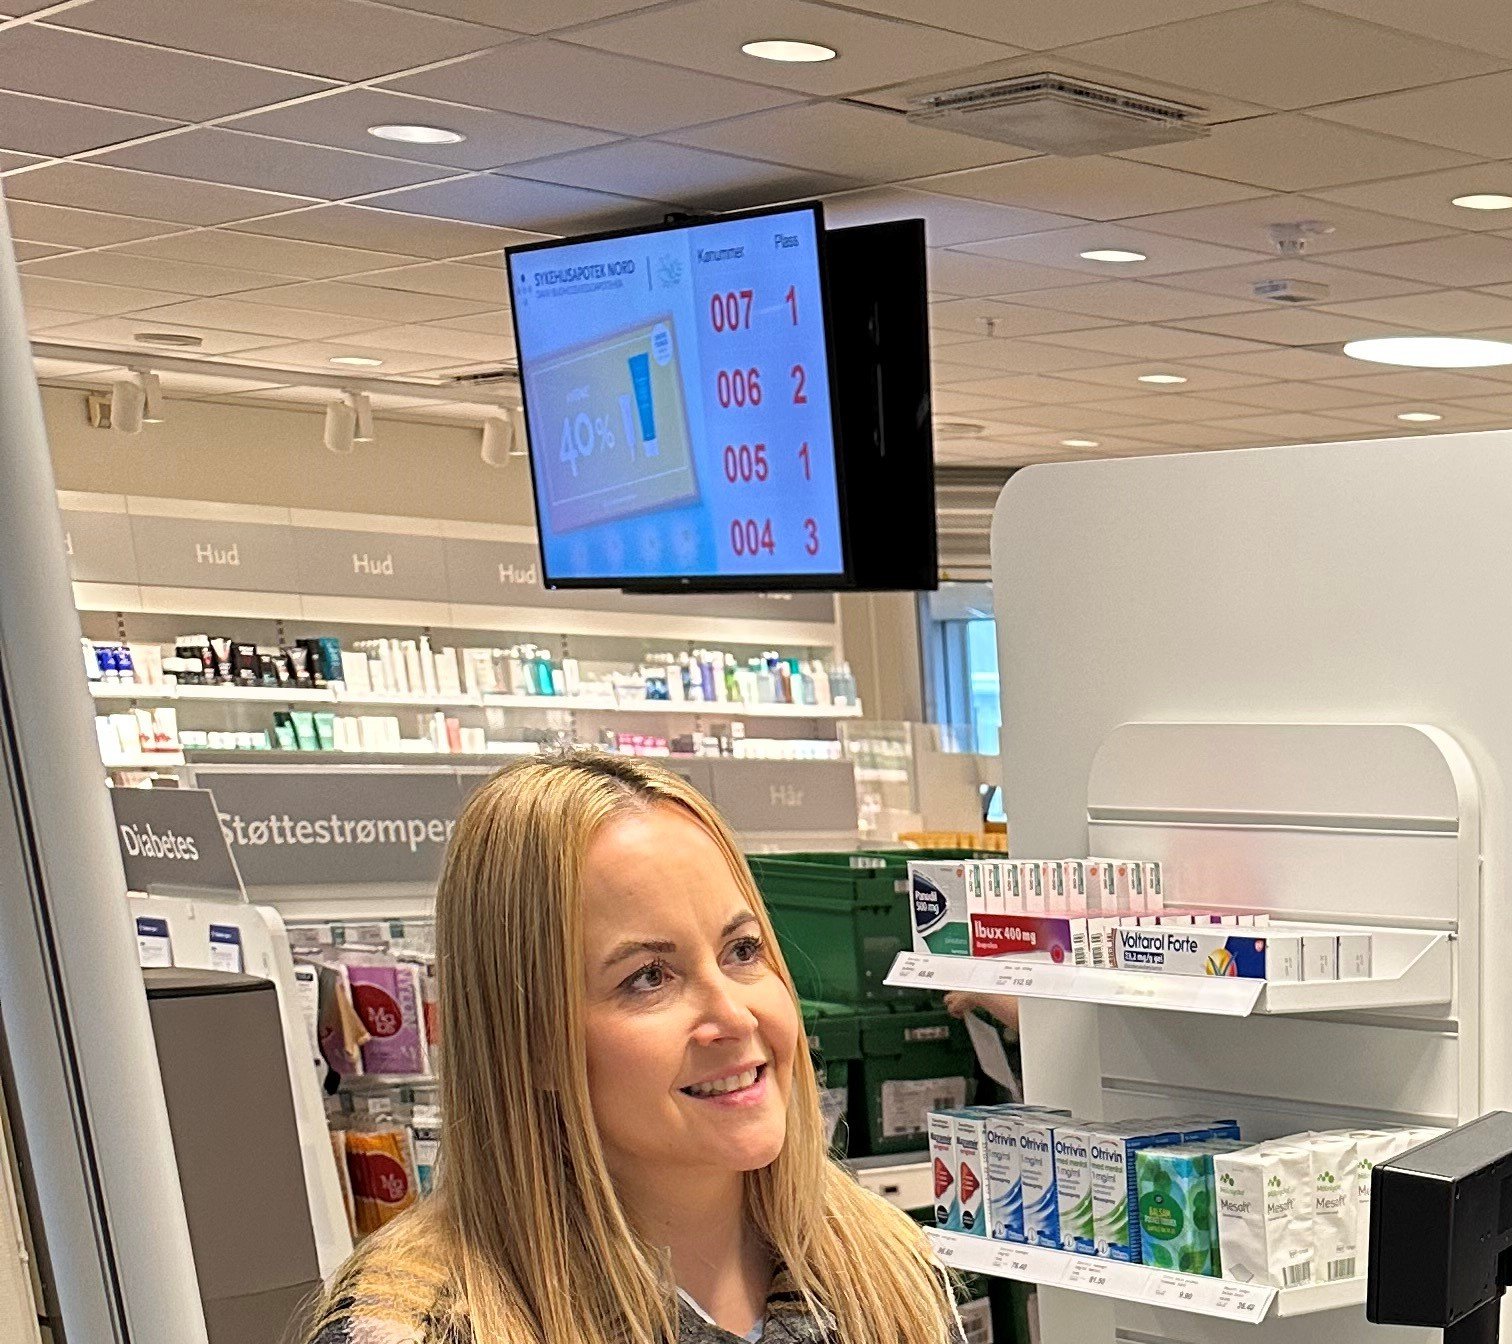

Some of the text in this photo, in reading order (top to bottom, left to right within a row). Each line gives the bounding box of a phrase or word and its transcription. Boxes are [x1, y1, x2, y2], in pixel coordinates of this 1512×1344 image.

[608, 259, 635, 275] NORD
[710, 285, 798, 332] 007 1
[716, 364, 807, 408] 006 2
[559, 412, 616, 477] 40%
[723, 442, 812, 483] 005 1
[730, 517, 819, 557] 004 3
[195, 543, 241, 567] Hud
[353, 552, 395, 575] Hud
[498, 563, 537, 584] Hud
[119, 822, 199, 862] Diabetes
[218, 812, 457, 852] Støttestrømper
[928, 904, 939, 915] mg
[974, 920, 1037, 945] Ibux 400 mg
[1120, 930, 1198, 953] Voltarol Forte
[988, 1130, 1017, 1147] Otrivin
[1020, 1136, 1049, 1153] Otrivin
[1056, 1141, 1087, 1158] Otrivin
[1091, 1146, 1123, 1163] Otrivin
[1220, 1199, 1251, 1213] Mesoft
[1267, 1198, 1296, 1214] Mesoft
[1316, 1195, 1346, 1209] Mesoft
